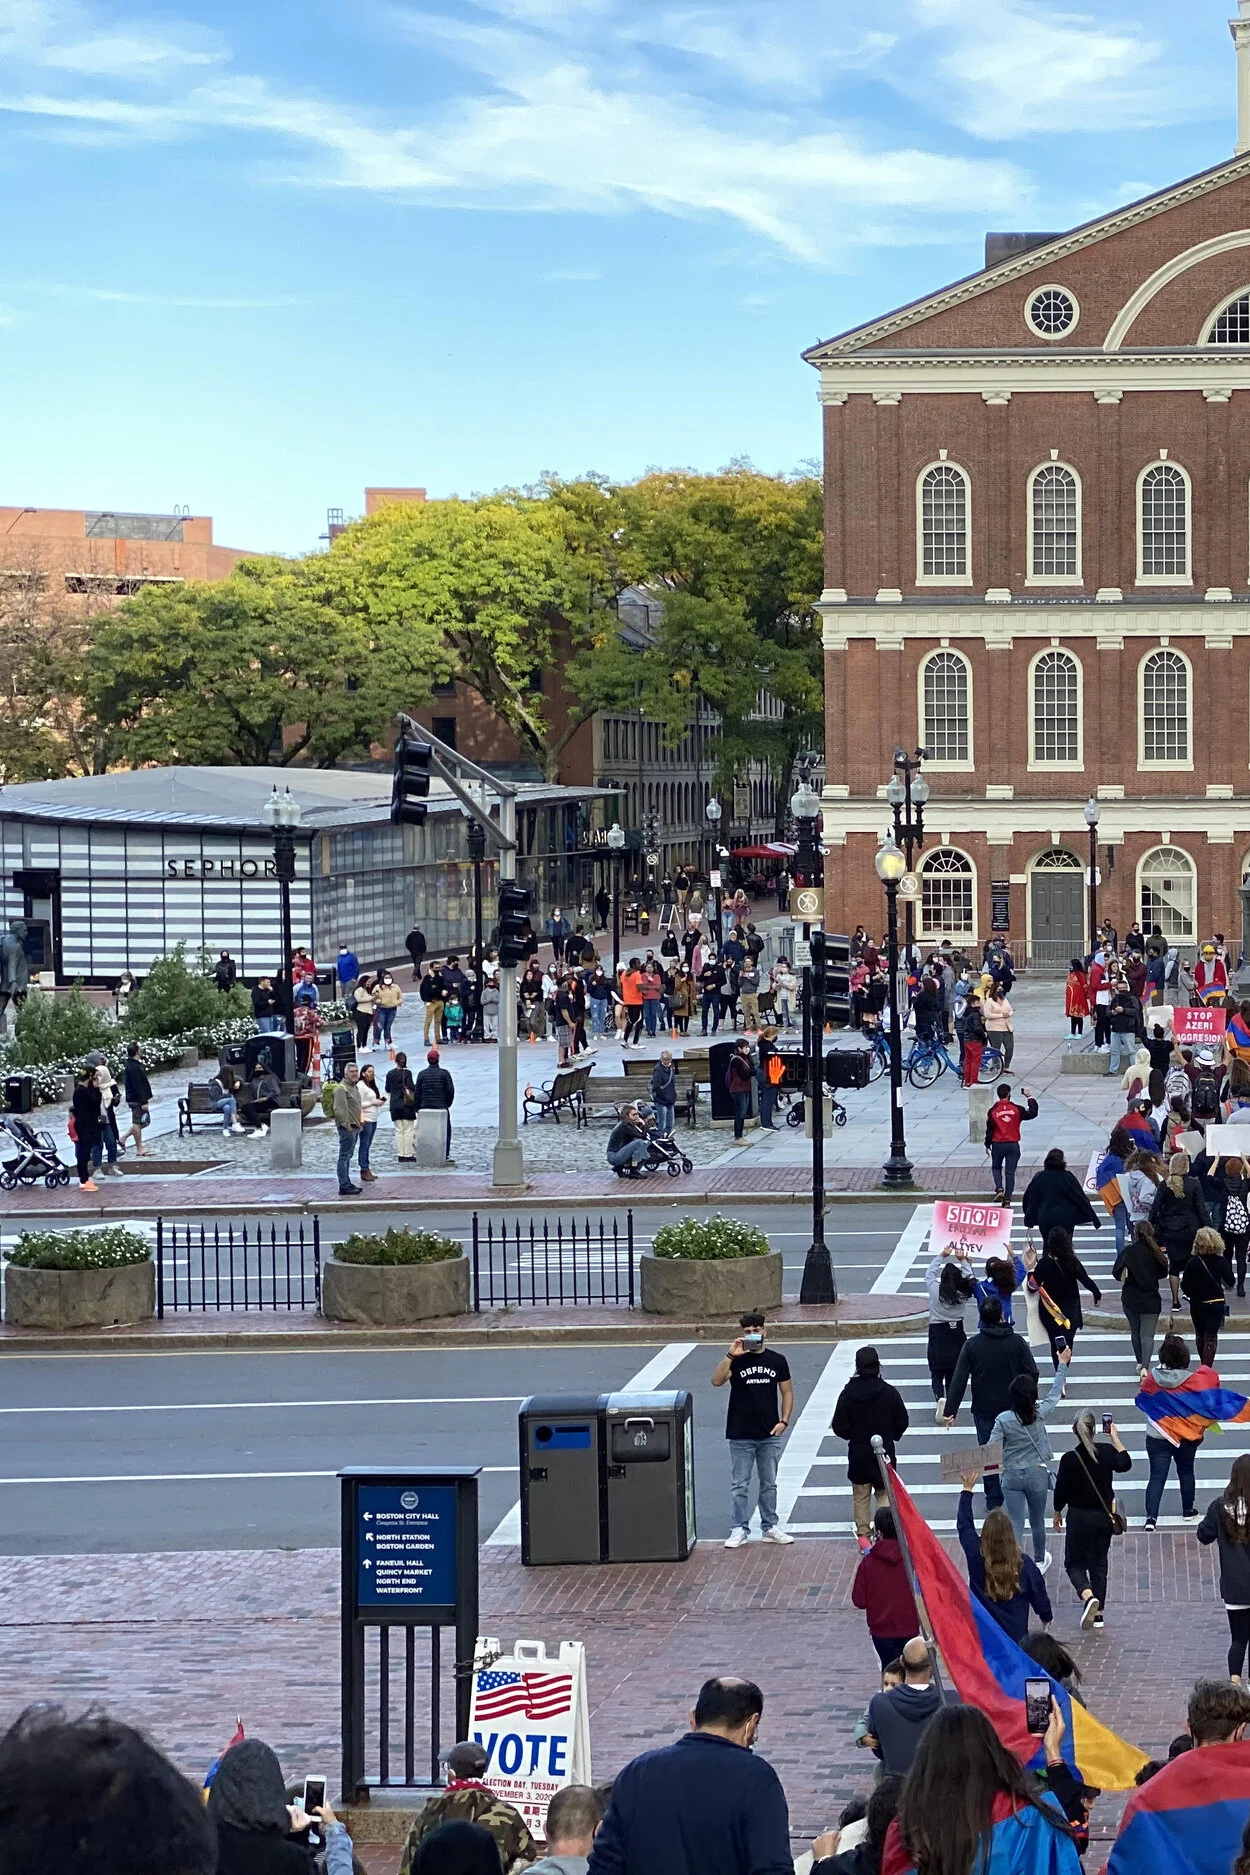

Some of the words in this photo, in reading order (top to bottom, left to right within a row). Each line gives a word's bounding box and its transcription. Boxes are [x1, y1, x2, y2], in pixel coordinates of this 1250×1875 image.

[167, 859, 278, 877] SEPHOR
[1186, 1011, 1213, 1020] STOP
[1185, 1021, 1213, 1031] AZERI
[947, 1206, 1000, 1226] STOP
[948, 1241, 983, 1253] ALIYEV
[740, 1366, 777, 1378] DEFEND
[473, 1732, 568, 1777] VOTE
[530, 1782, 560, 1791] TUESDAY
[535, 1793, 553, 1801] 2020
